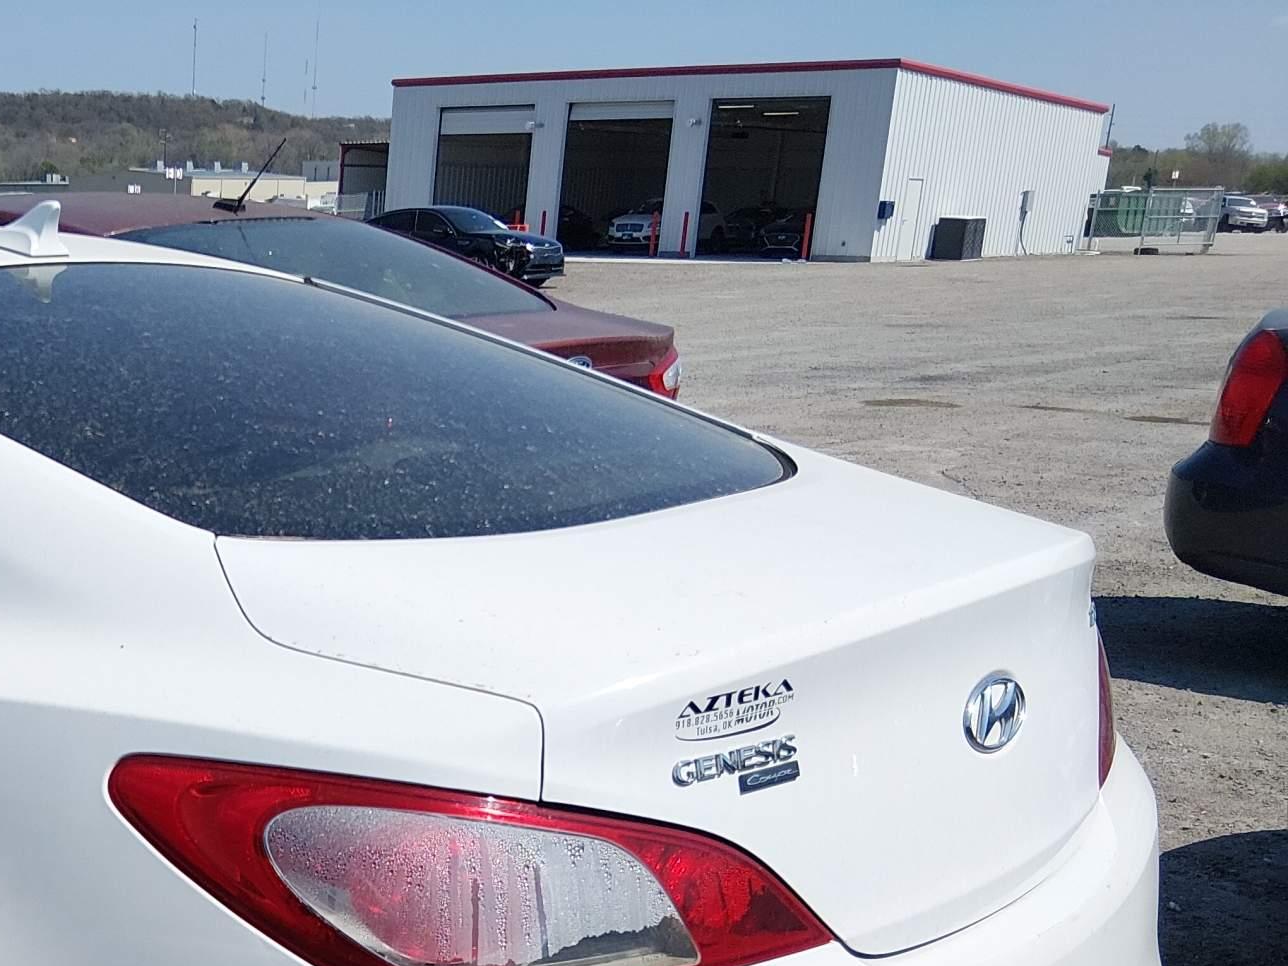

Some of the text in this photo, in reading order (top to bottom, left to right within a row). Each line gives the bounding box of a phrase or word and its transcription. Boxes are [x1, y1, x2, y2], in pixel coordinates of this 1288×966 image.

[677, 678, 793, 719] AZTEKA
[675, 708, 734, 730] 918.828.5656
[695, 719, 733, 736] Tulsa, OK
[672, 734, 798, 787] GENESIS
[747, 768, 799, 786] Coupe
